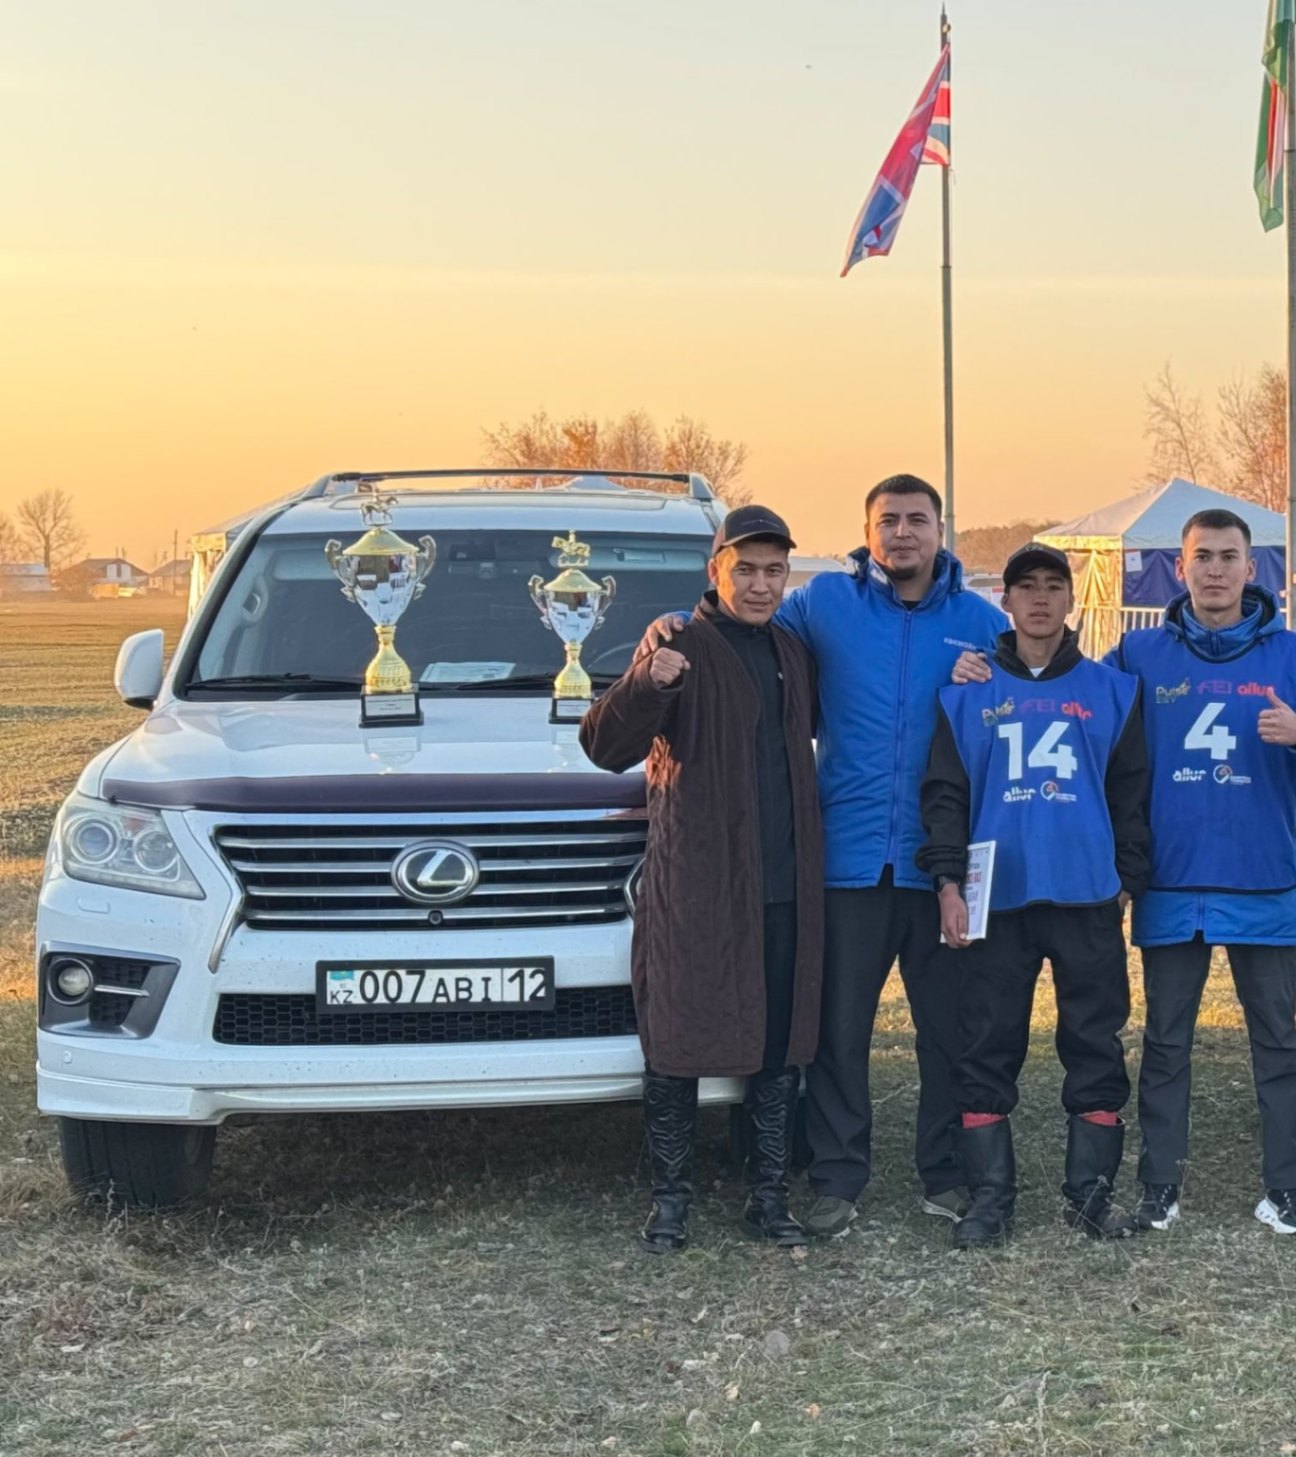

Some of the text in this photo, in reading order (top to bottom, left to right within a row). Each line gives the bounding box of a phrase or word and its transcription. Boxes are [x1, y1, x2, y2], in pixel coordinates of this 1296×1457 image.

[1184, 702, 1237, 760] 4
[998, 721, 1077, 780] 14
[1172, 767, 1207, 783] allur
[1003, 787, 1036, 803] allur
[330, 990, 354, 1004] KZ
[507, 969, 547, 1001] 12
